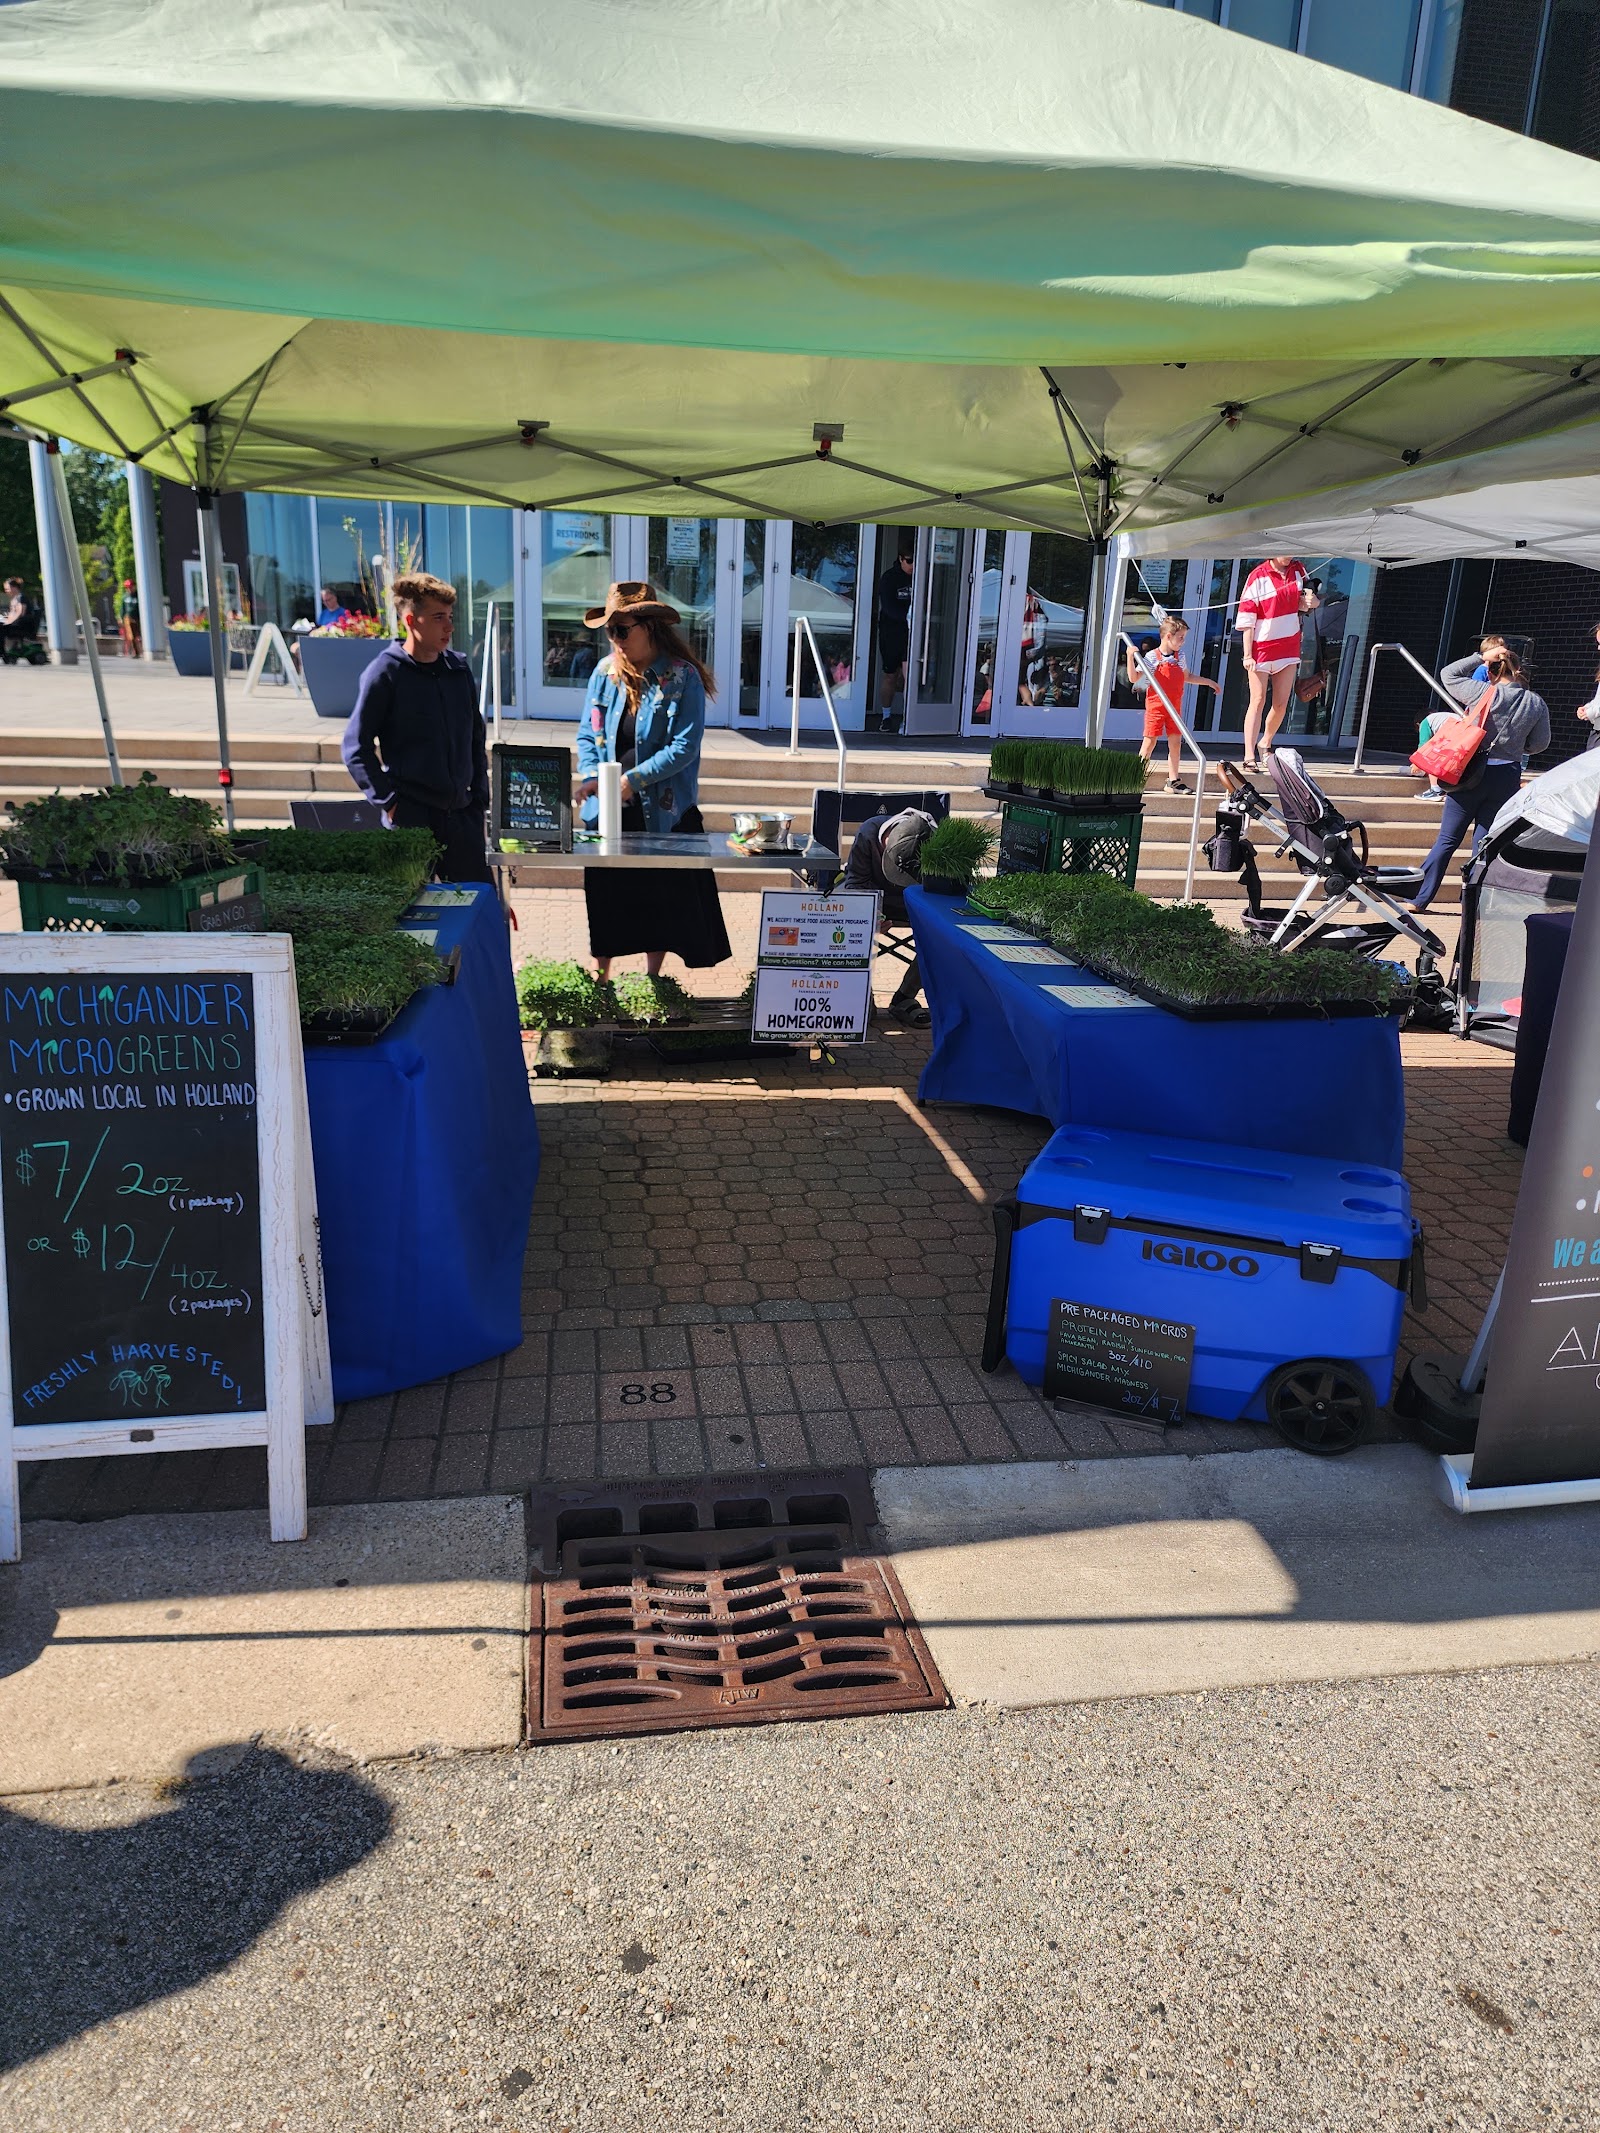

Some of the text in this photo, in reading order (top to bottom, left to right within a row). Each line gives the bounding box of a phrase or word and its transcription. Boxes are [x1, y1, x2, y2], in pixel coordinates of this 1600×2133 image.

[556, 529, 600, 540] RESTROOMS
[802, 904, 844, 912] HOLLAND
[782, 958, 818, 966] Questions?
[792, 980, 839, 988] HOLLAND
[794, 998, 832, 1012] 100%
[768, 1014, 854, 1029] HOMEGROWN
[16, 1082, 256, 1112] GROWN LOCAL IN HOLLAND
[27, 1236, 59, 1252] OR
[1553, 1237, 1587, 1269] We
[1141, 1240, 1260, 1277] IGLOO
[190, 1288, 251, 1317] packages)
[1060, 1302, 1080, 1317] PRE
[1083, 1308, 1140, 1329] PACKAGED
[1062, 1320, 1134, 1345] PROTEIN MIX
[1058, 1351, 1131, 1377] SPICY SALAD MIX
[22, 1342, 243, 1408] FRESHLY HARVESTED!
[1056, 1362, 1149, 1390] MICHIGANDER MADNESS
[620, 1382, 676, 1404] 88
[712, 1474, 754, 1485] DRAINS
[760, 1472, 774, 1482] TO
[778, 1468, 846, 1481] WATERWAYS
[662, 1589, 708, 1598] JORDAN
[666, 1627, 778, 1644] MADE IN USA
